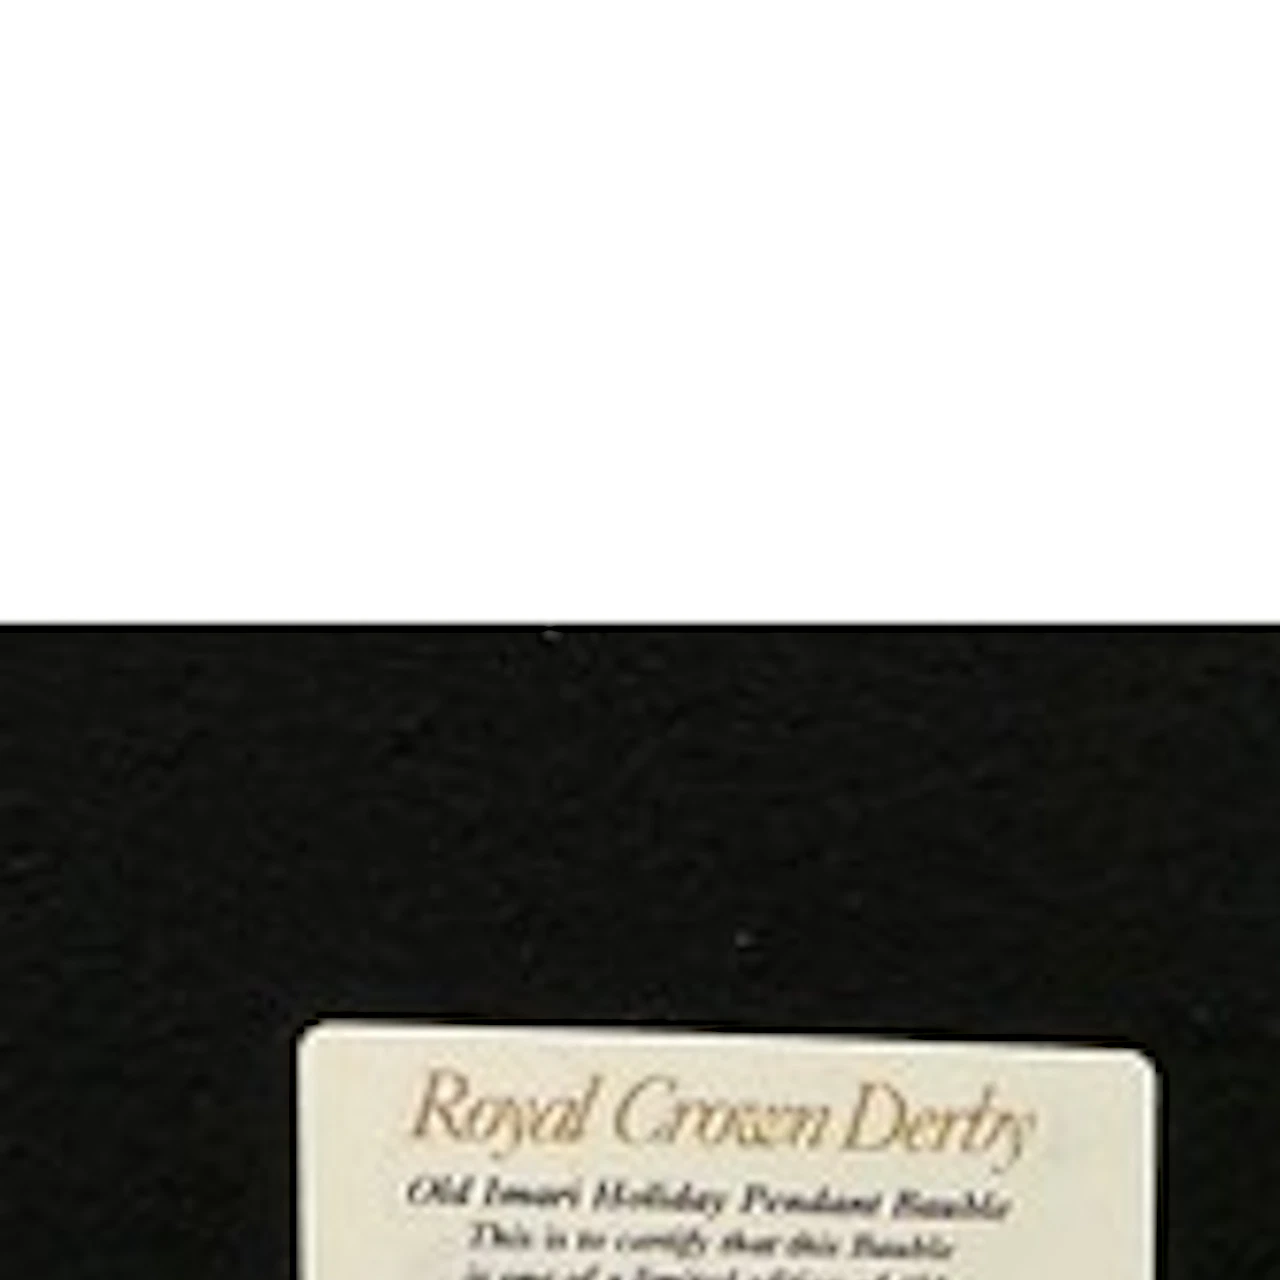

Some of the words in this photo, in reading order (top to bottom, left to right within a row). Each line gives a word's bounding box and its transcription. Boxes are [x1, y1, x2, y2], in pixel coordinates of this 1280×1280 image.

[412, 1068, 603, 1160] Royal
[614, 1074, 830, 1146] Crown
[846, 1080, 1037, 1175] Derby
[406, 1174, 478, 1206] Old
[468, 1220, 533, 1250] This
